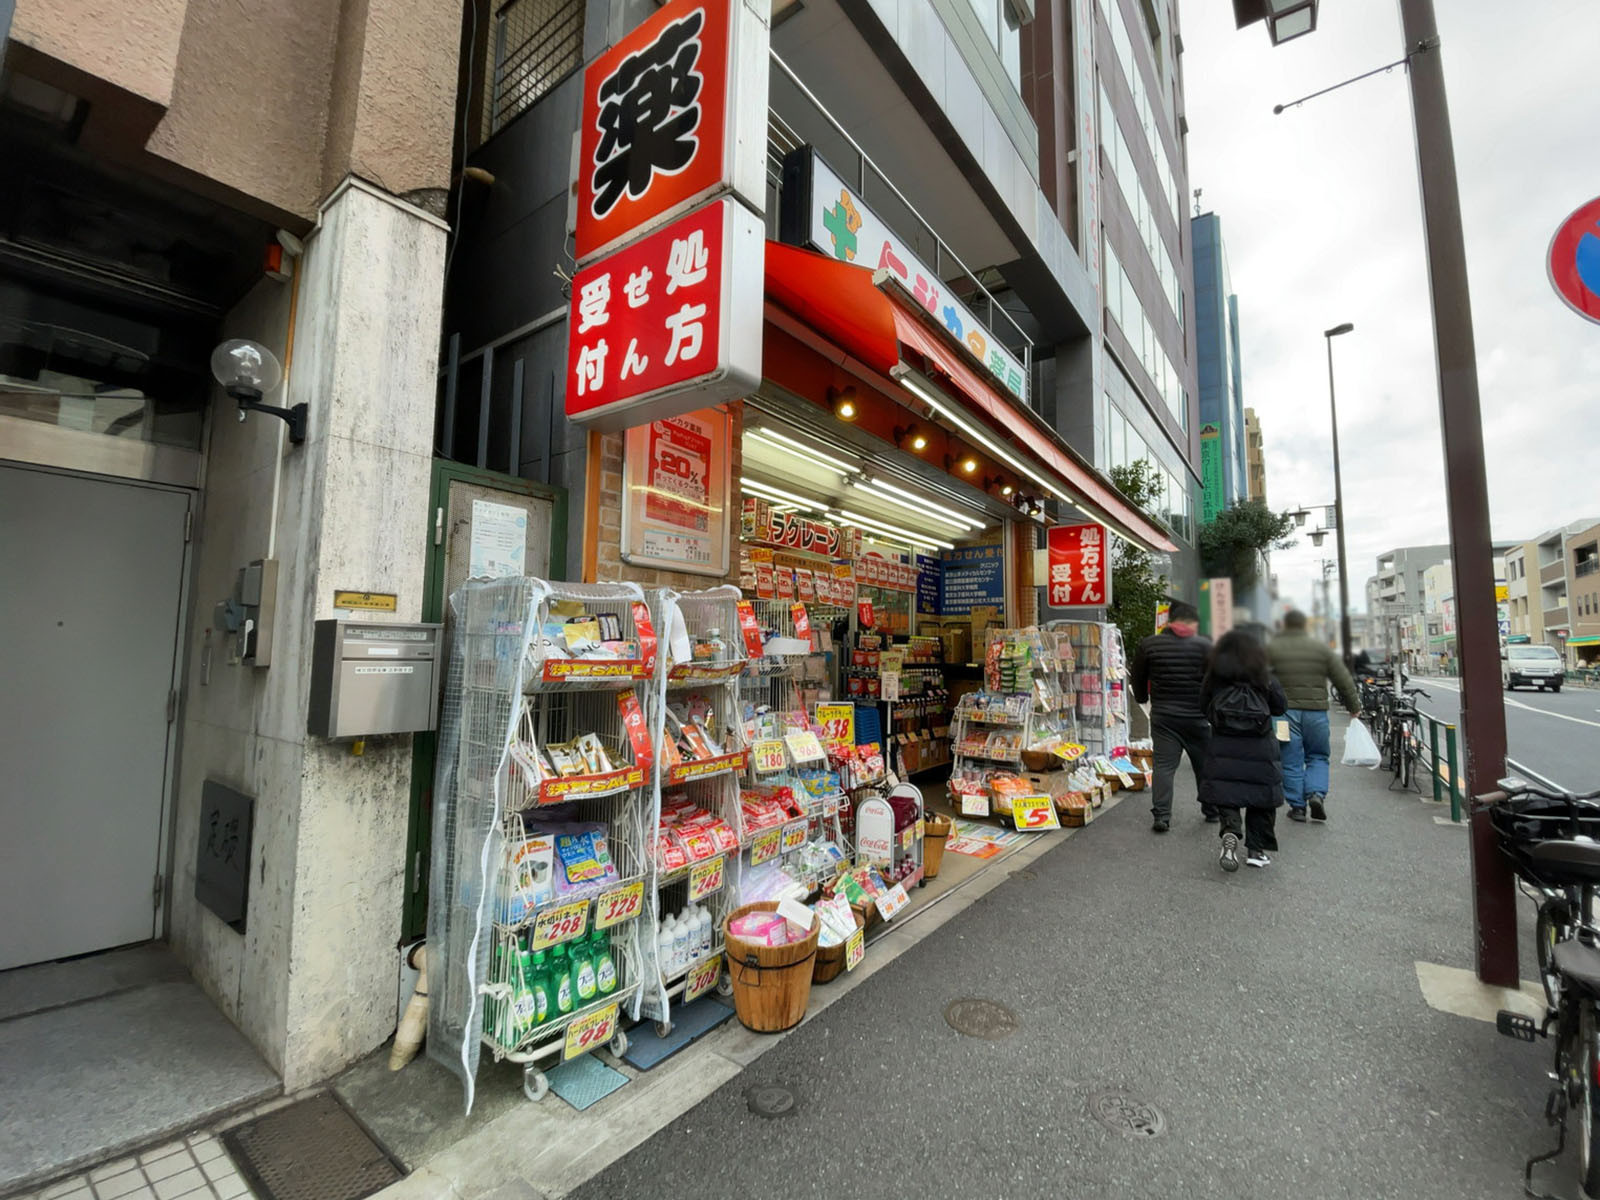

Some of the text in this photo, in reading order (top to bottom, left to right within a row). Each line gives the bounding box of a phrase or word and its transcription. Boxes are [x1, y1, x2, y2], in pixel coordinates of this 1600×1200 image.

[592, 7, 705, 219] 薬
[665, 229, 709, 367] 処方
[576, 273, 611, 396] 受付
[621, 266, 652, 380] せん
[661, 450, 698, 484] 20%
[1080, 527, 1100, 602] 処方せん
[1052, 564, 1072, 602] 受付
[765, 754, 783, 768] 180
[1026, 808, 1050, 827] 5
[537, 907, 587, 928] 水切りネット
[605, 894, 638, 921] 328
[549, 916, 582, 941] 298
[579, 1021, 610, 1048] 98
